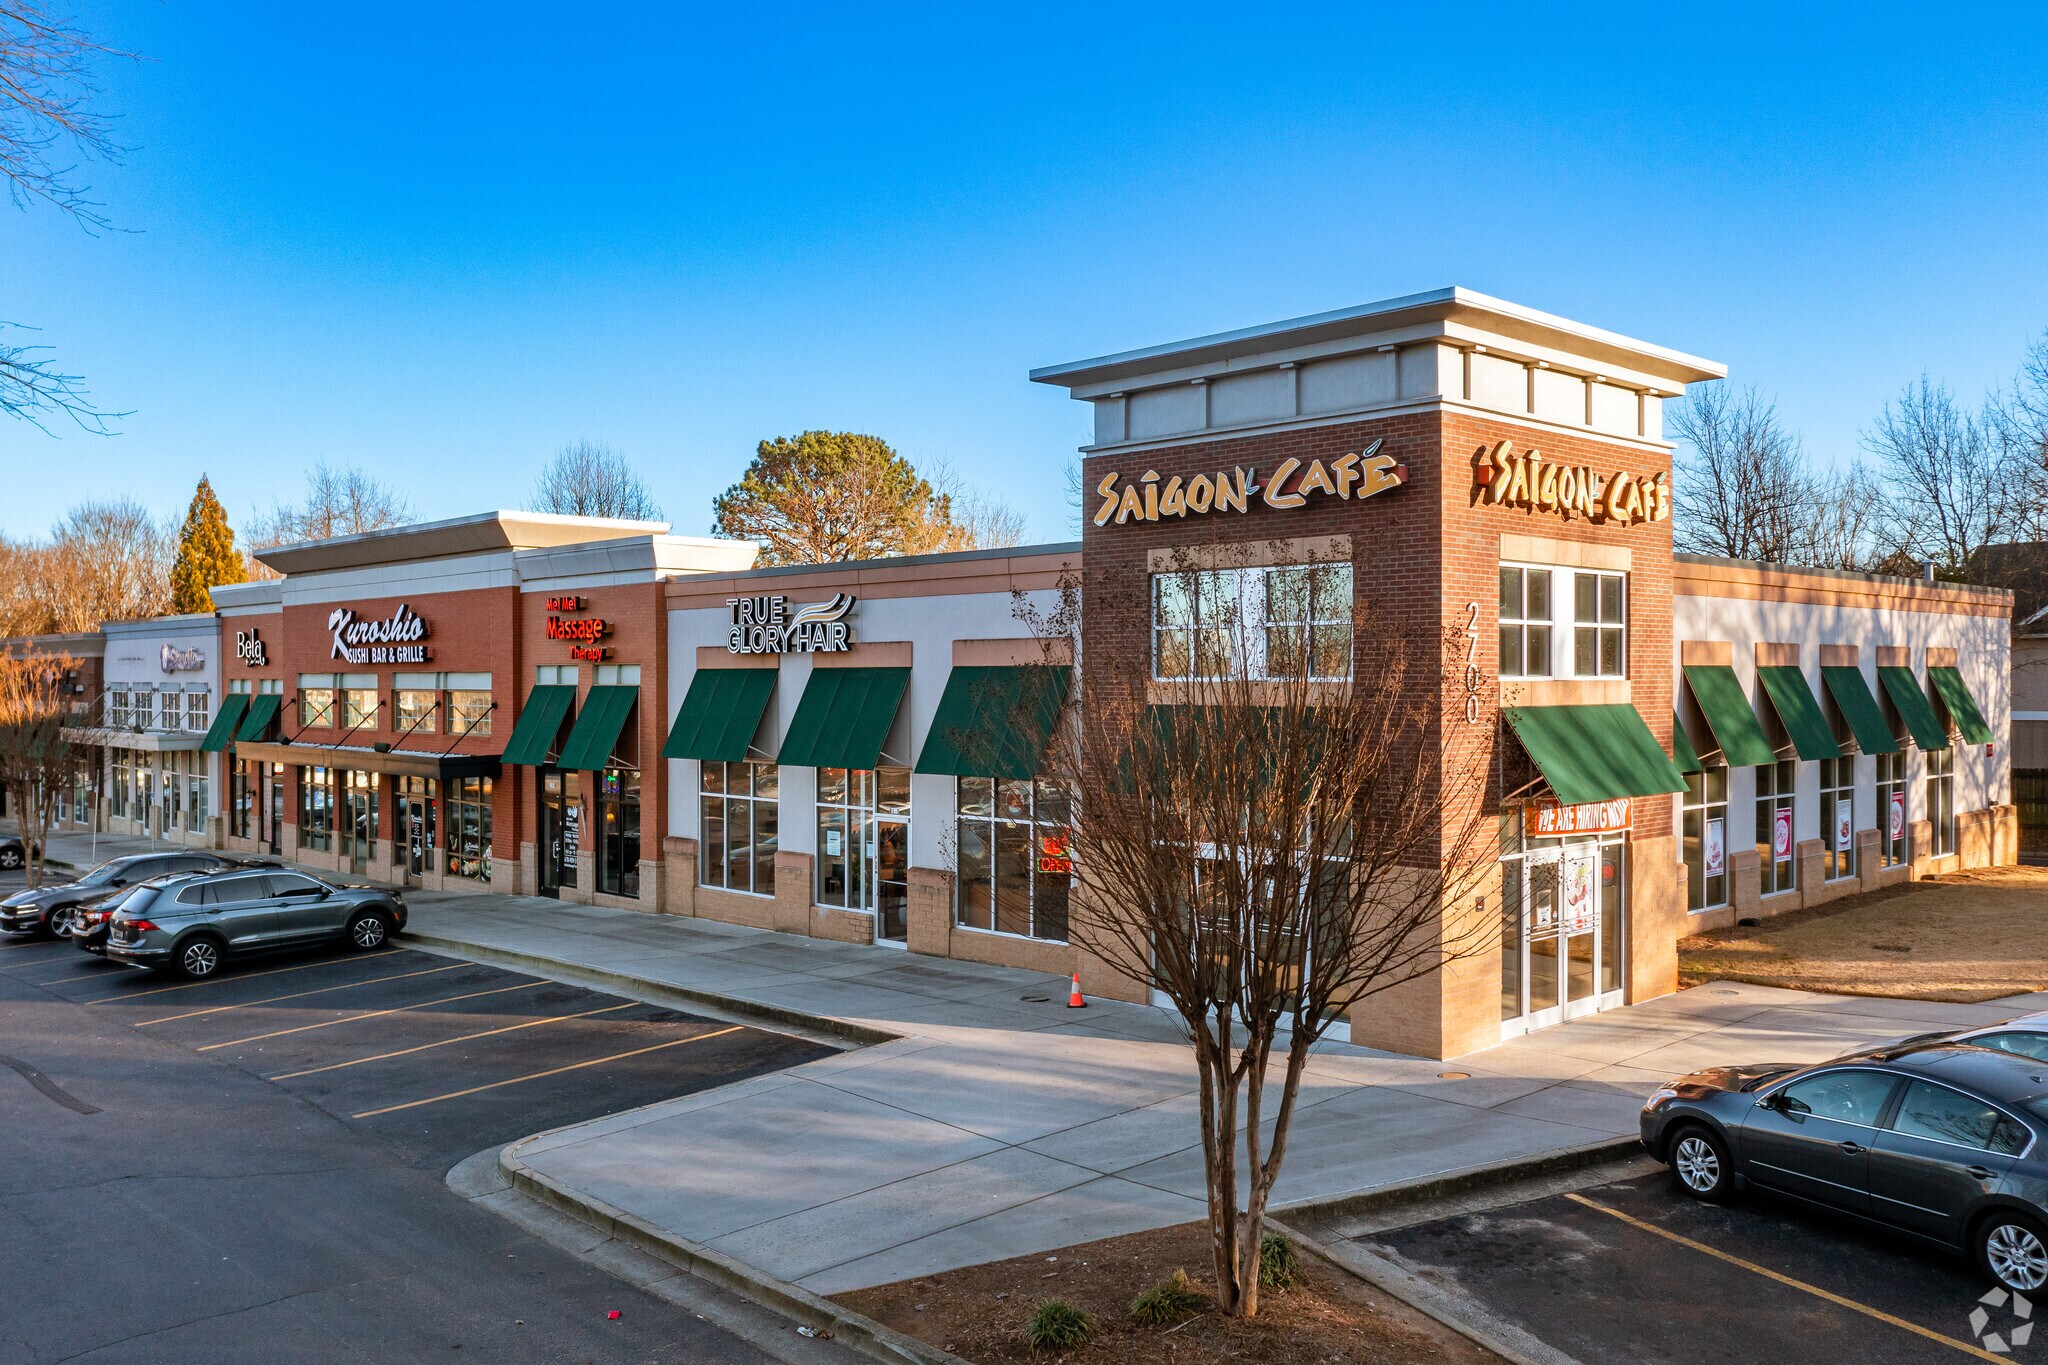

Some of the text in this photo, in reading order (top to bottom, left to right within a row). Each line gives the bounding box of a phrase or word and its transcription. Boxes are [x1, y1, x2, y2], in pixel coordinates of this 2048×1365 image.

[1264, 438, 1402, 509] CAFÉ
[726, 596, 784, 625] TRUE
[328, 603, 423, 660] Kuroshio
[546, 616, 603, 644] Massage
[726, 622, 849, 654] GLORY HAIR
[236, 628, 265, 666] Bela
[349, 646, 424, 664] SUSHI BAR & GRILLE
[568, 645, 603, 662] Therapy
[1465, 601, 1479, 724] 2700
[1538, 803, 1555, 832] WE
[1556, 805, 1574, 832] ARE
[1575, 801, 1608, 830] HIRING
